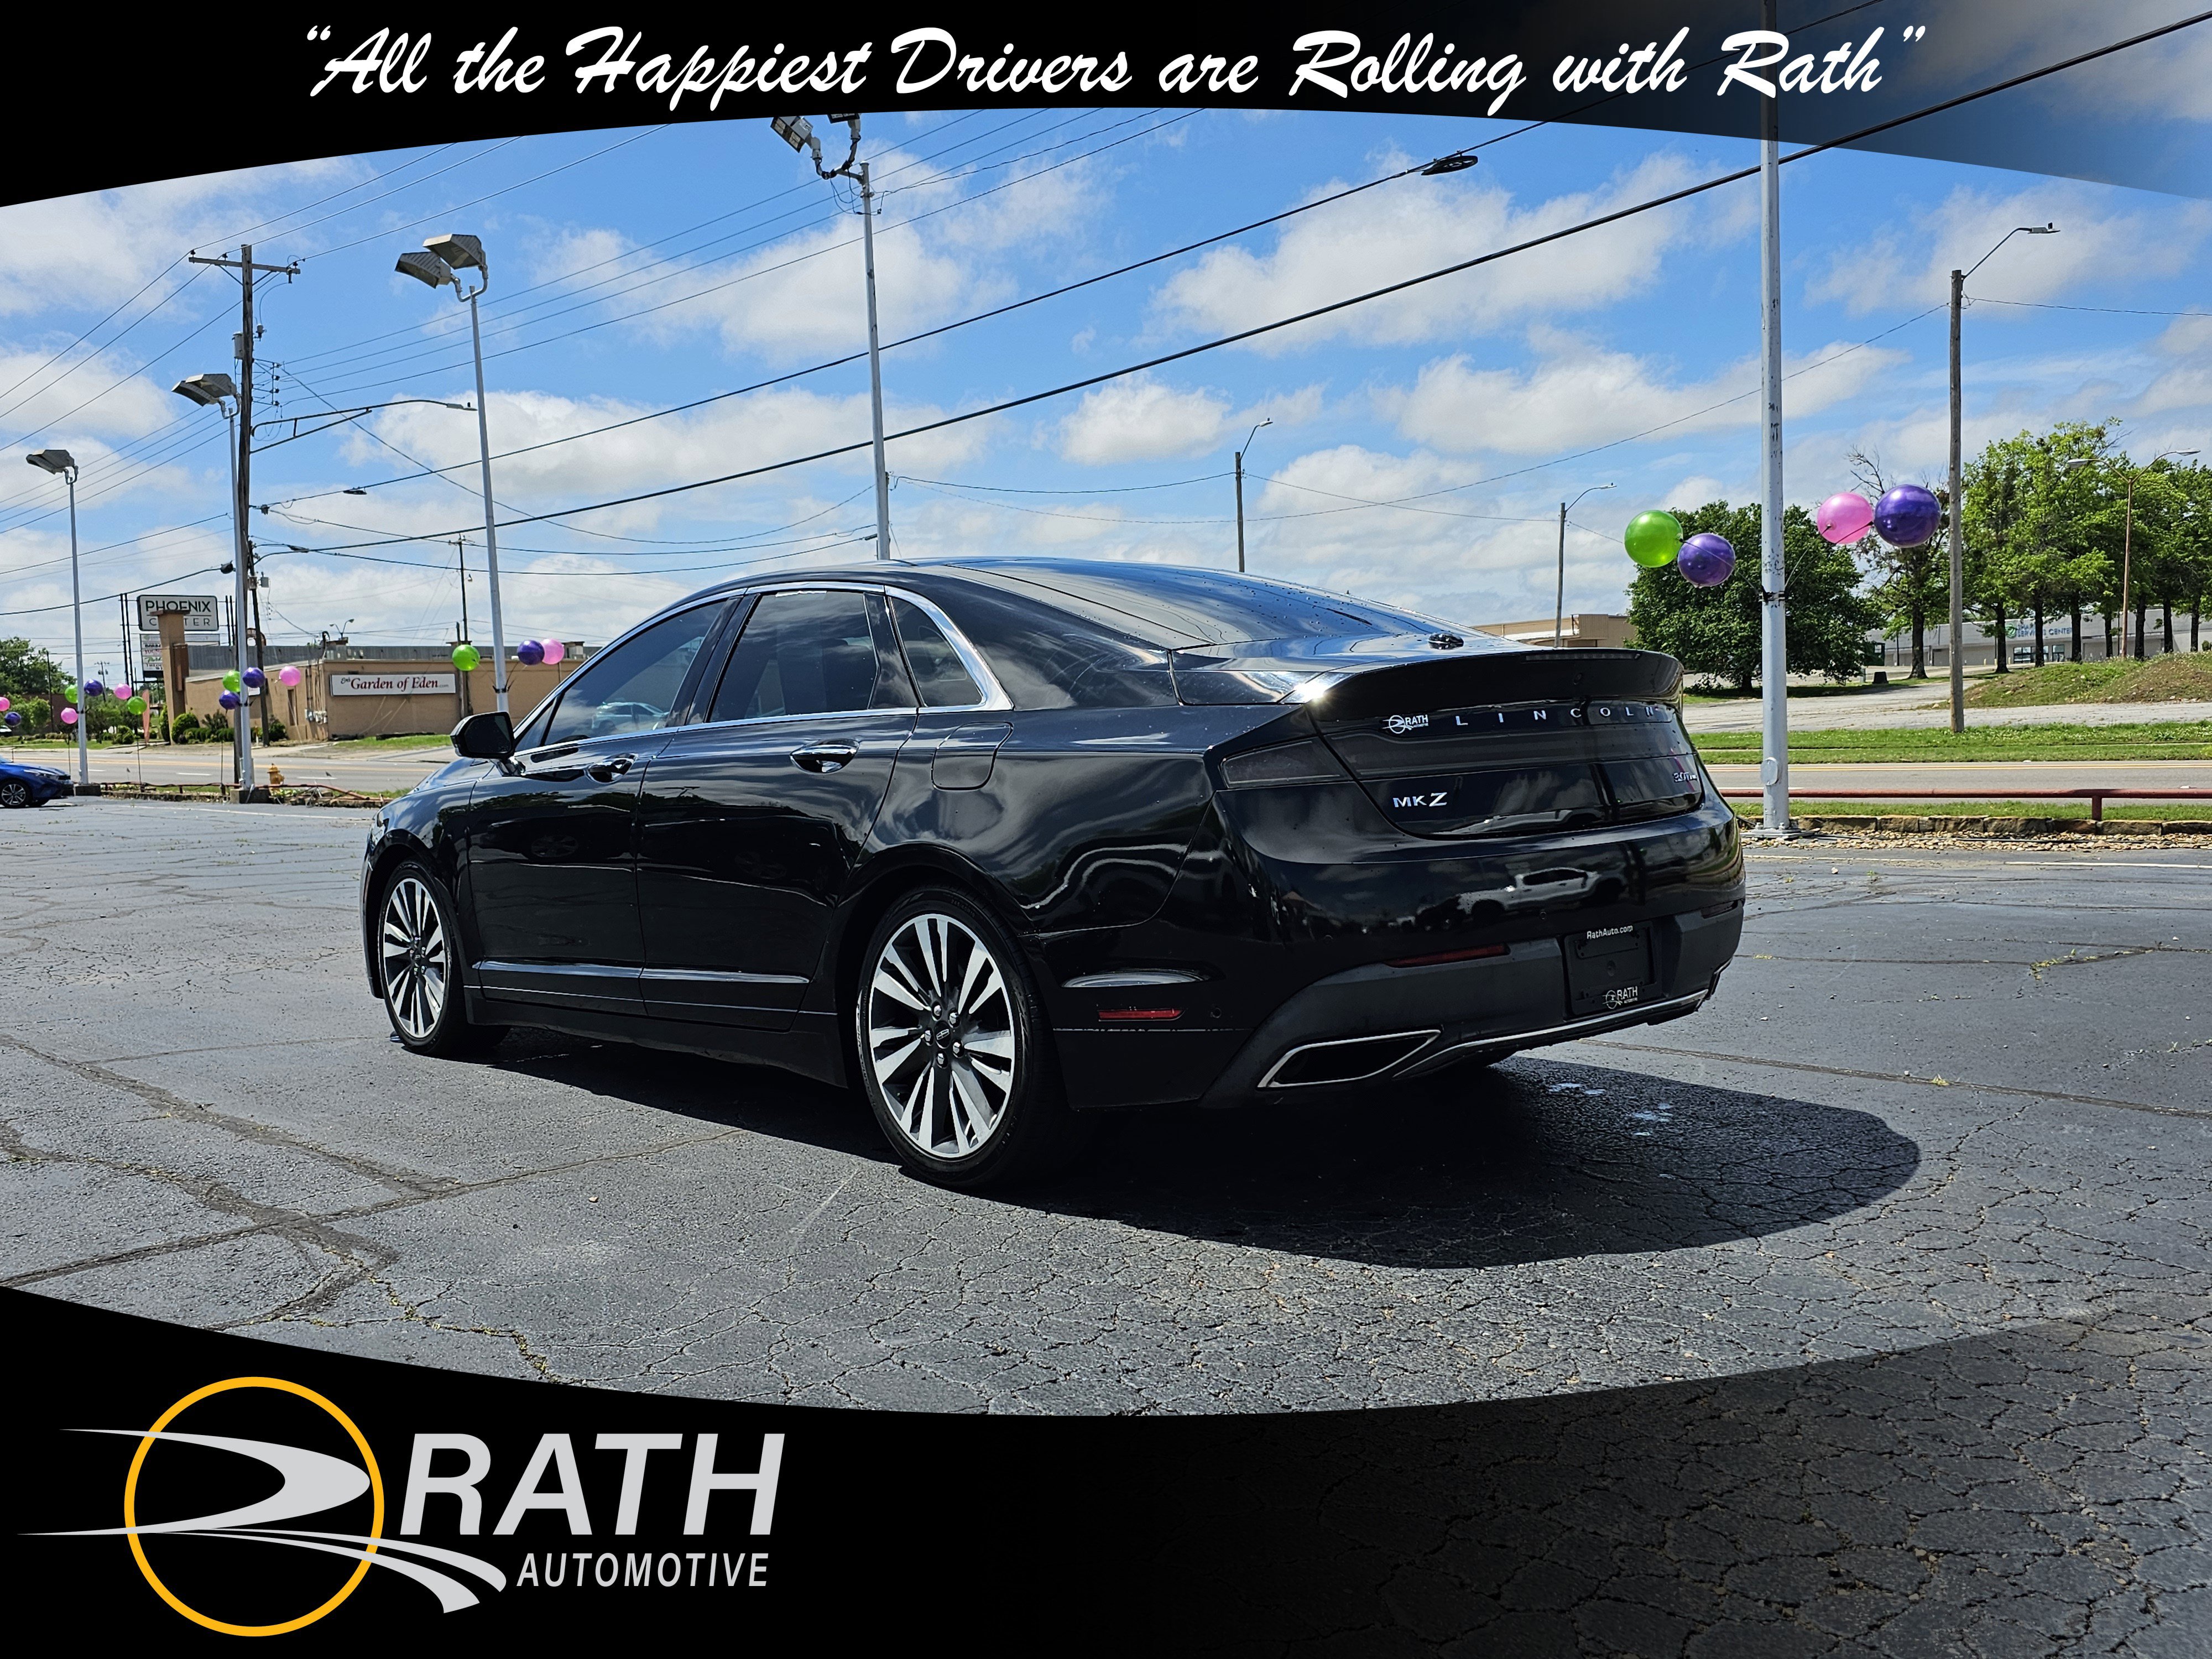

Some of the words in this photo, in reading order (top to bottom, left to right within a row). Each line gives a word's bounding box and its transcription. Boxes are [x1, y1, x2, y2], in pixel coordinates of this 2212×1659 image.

[145, 601, 211, 612] PHOENIX
[149, 618, 210, 626] CTER
[351, 677, 393, 690] Garden
[397, 676, 410, 691] of
[1405, 714, 1429, 725] RATH
[1455, 706, 1654, 726] LINCOLN
[1392, 792, 1448, 807] MKZ
[1587, 925, 1634, 940] RathAuto.com
[1616, 985, 1638, 1000] RATH
